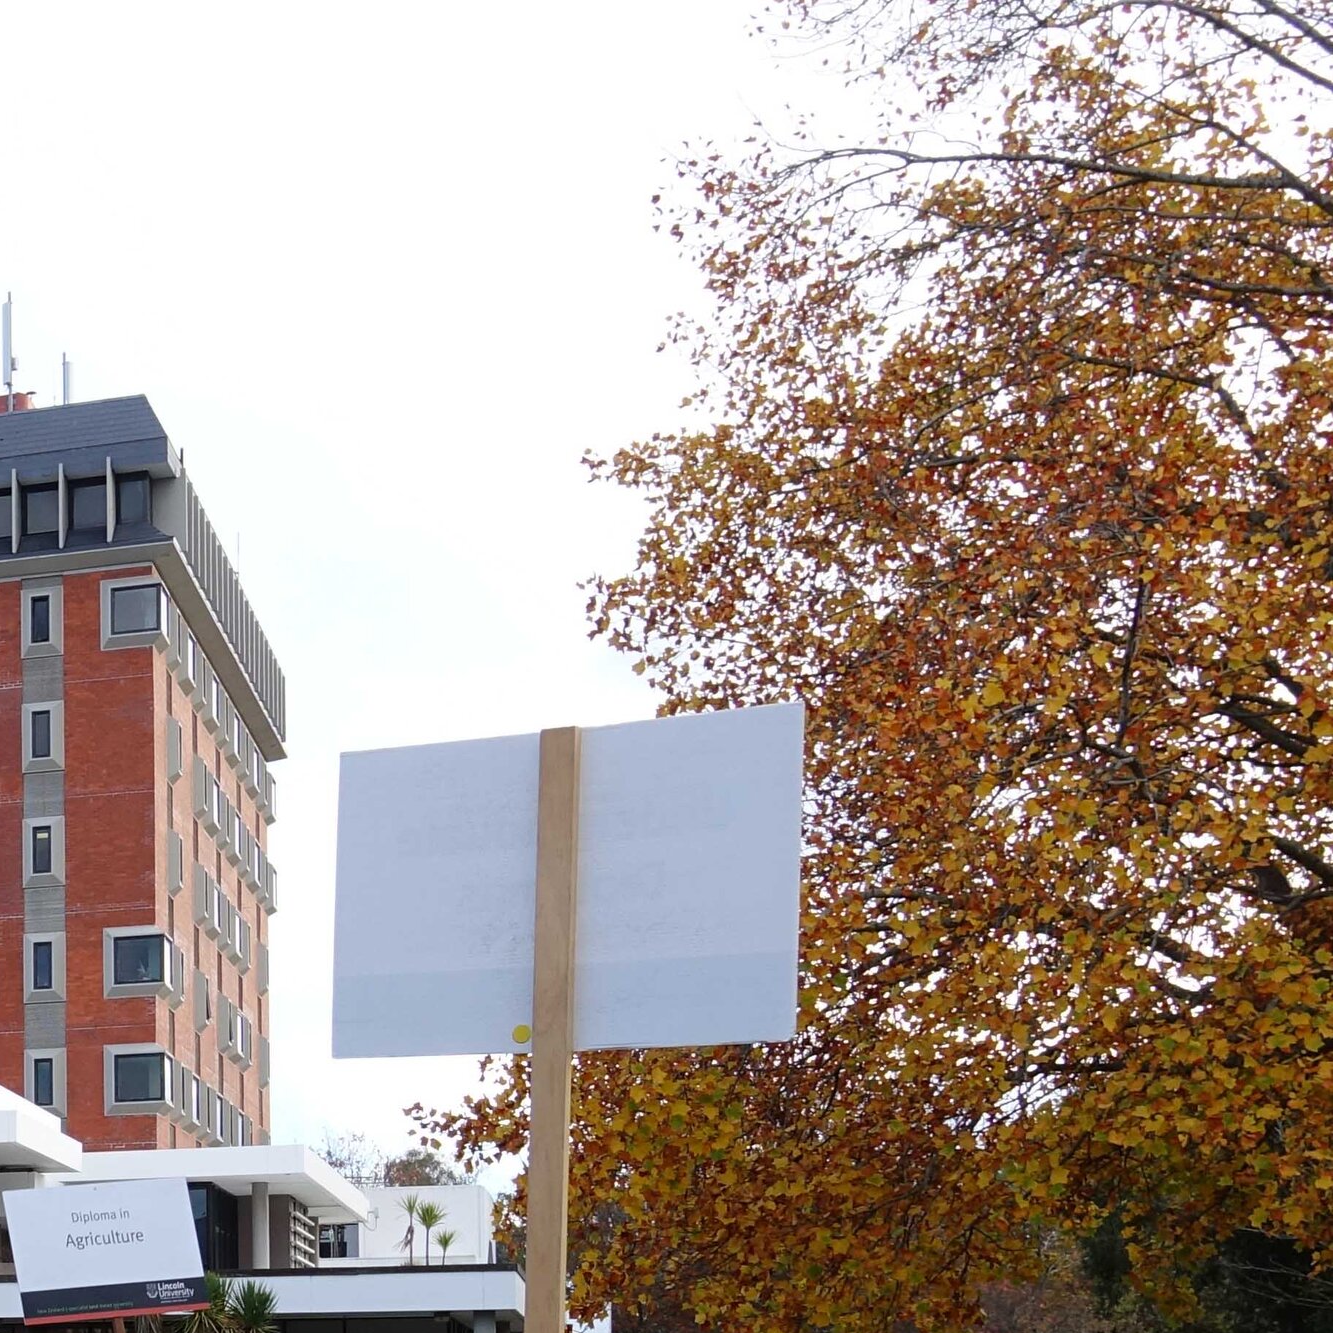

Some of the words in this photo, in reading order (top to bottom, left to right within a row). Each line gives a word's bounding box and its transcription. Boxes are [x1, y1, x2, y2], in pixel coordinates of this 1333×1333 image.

[71, 1210, 117, 1224] Diploma
[119, 1208, 130, 1219] in
[66, 1230, 144, 1250] Agriculture
[157, 1281, 185, 1290] Lincoln
[159, 1287, 195, 1298] University
